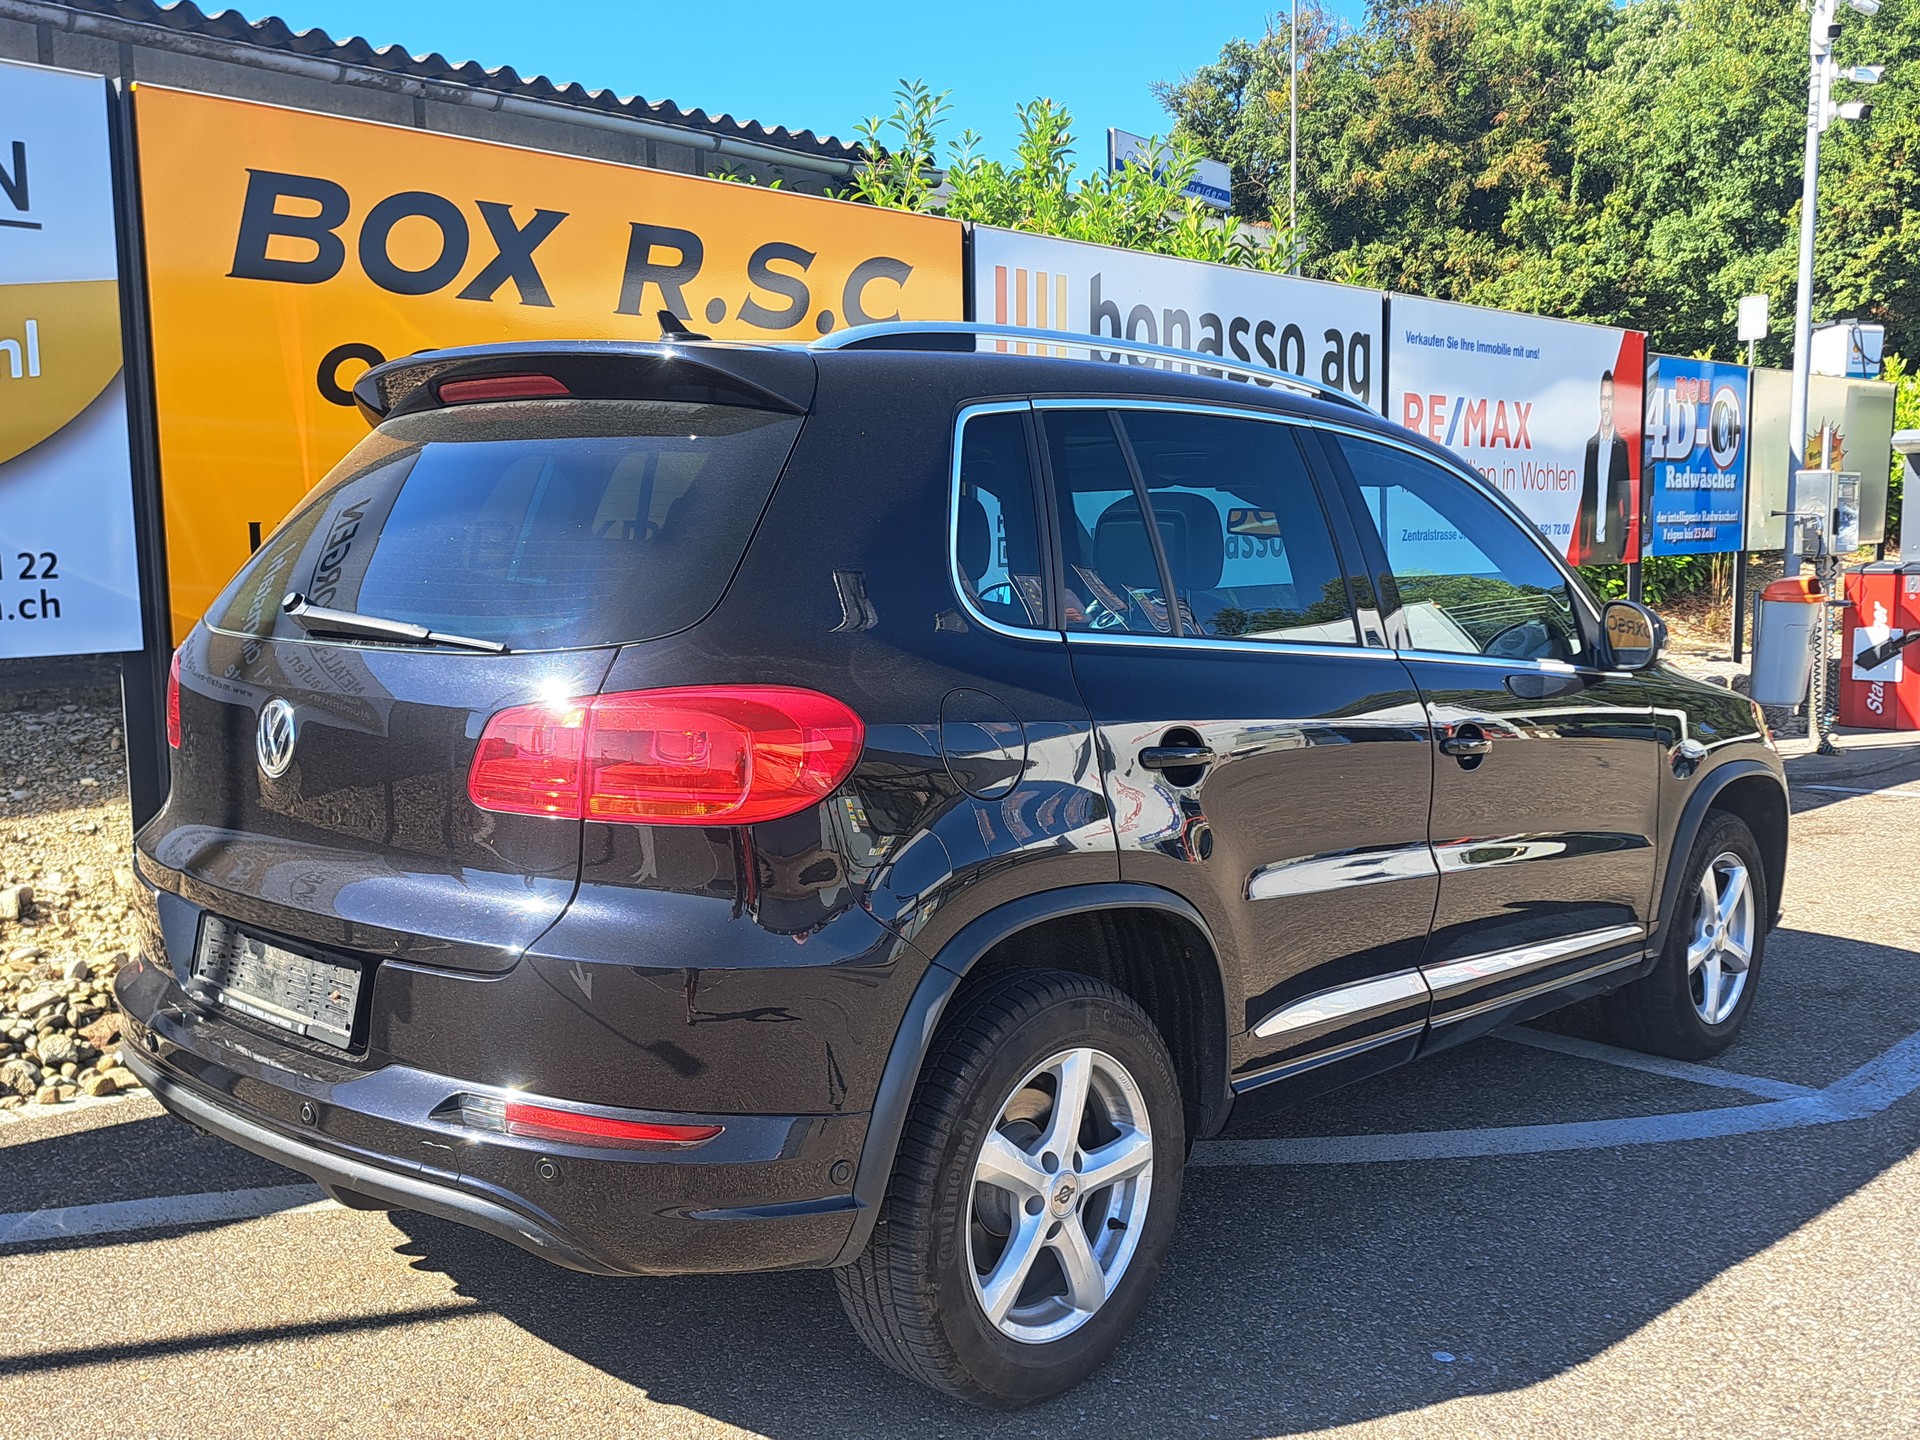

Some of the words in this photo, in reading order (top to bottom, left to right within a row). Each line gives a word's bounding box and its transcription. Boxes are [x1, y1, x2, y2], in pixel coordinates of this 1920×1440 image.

[225, 168, 570, 308] BOX
[1091, 272, 1305, 390] bonasso
[1321, 328, 1371, 406] ag
[1405, 330, 1445, 348] Verkaufen
[1446, 335, 1459, 350] Sie
[1460, 337, 1475, 352] Ihre
[1476, 339, 1512, 356] Immobilie
[1512, 344, 1524, 358] mit
[1525, 347, 1540, 360] uns!
[1403, 392, 1532, 449] RE/MAX
[1502, 461, 1516, 490] in
[1521, 461, 1577, 491] Wohlen
[1665, 464, 1737, 490] Radwäscher
[1656, 511, 1668, 523] der
[1402, 528, 1458, 542] Zentralstrasse
[1684, 527, 1694, 540] bis
[17, 552, 59, 581] 22
[0, 588, 61, 621] .ch
